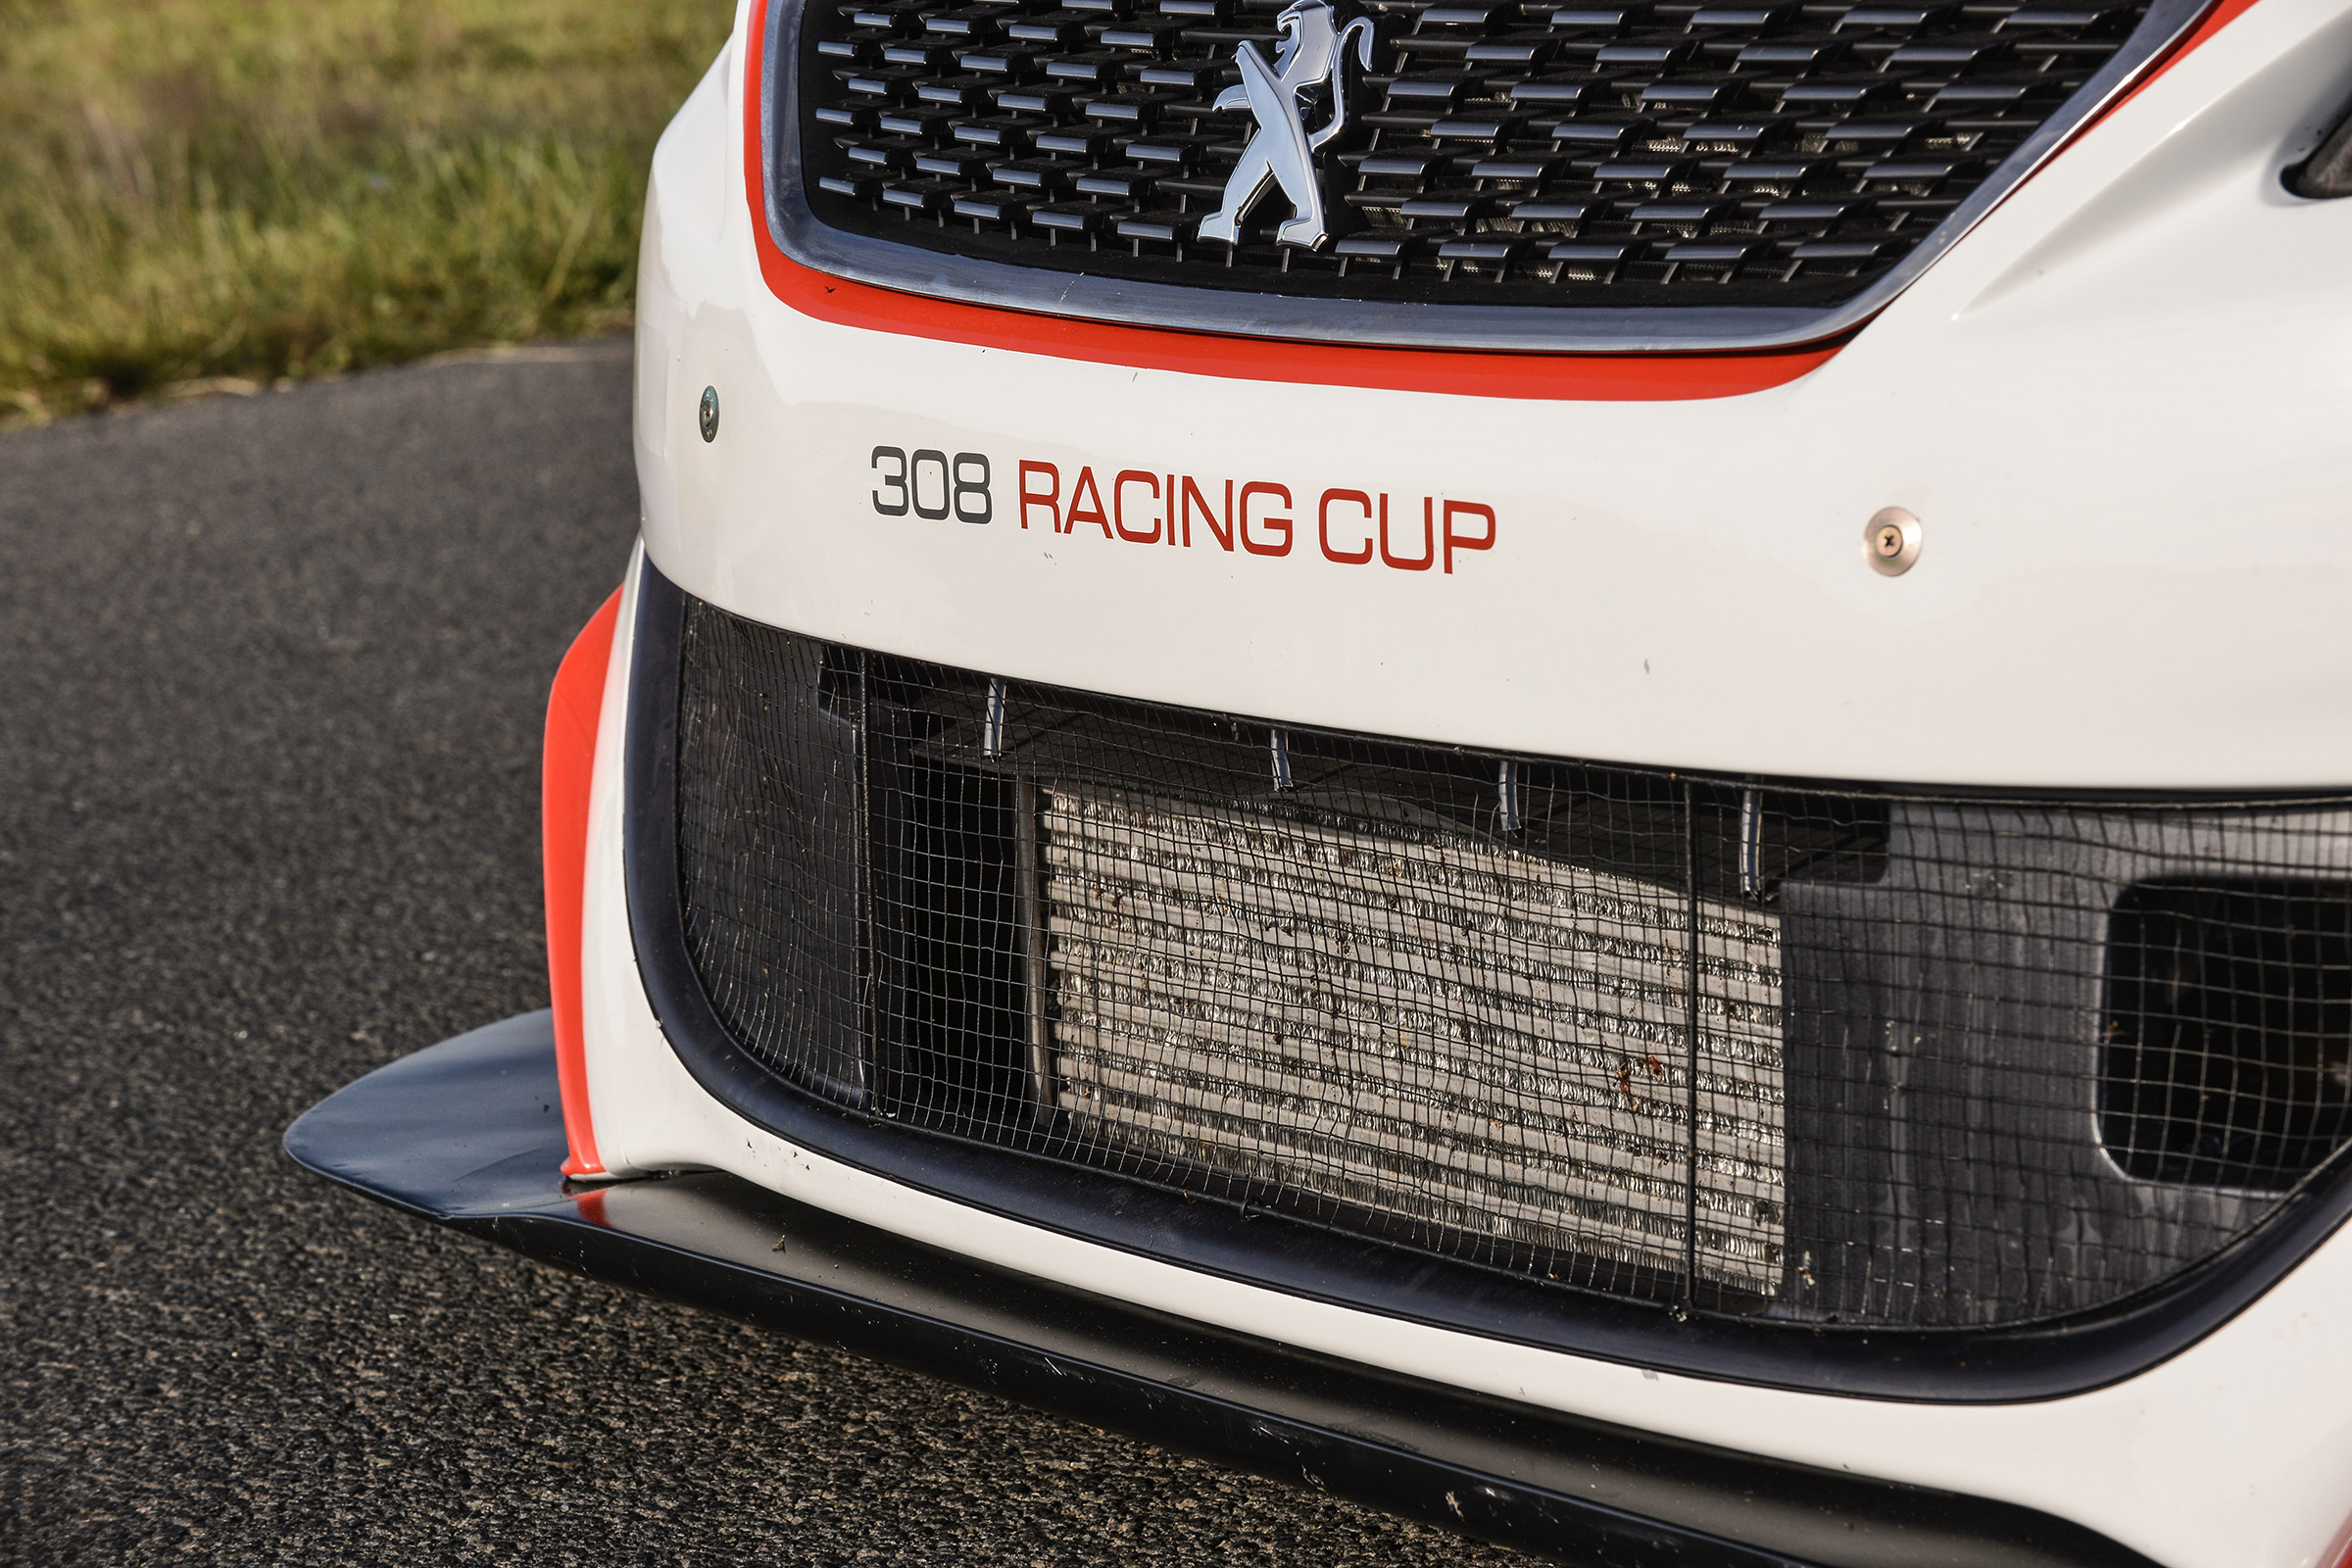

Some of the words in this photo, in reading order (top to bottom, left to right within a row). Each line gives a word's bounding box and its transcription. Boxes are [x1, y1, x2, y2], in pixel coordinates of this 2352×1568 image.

[870, 445, 993, 525] 308
[1018, 459, 1294, 558] RACING
[1318, 487, 1496, 575] CUP
